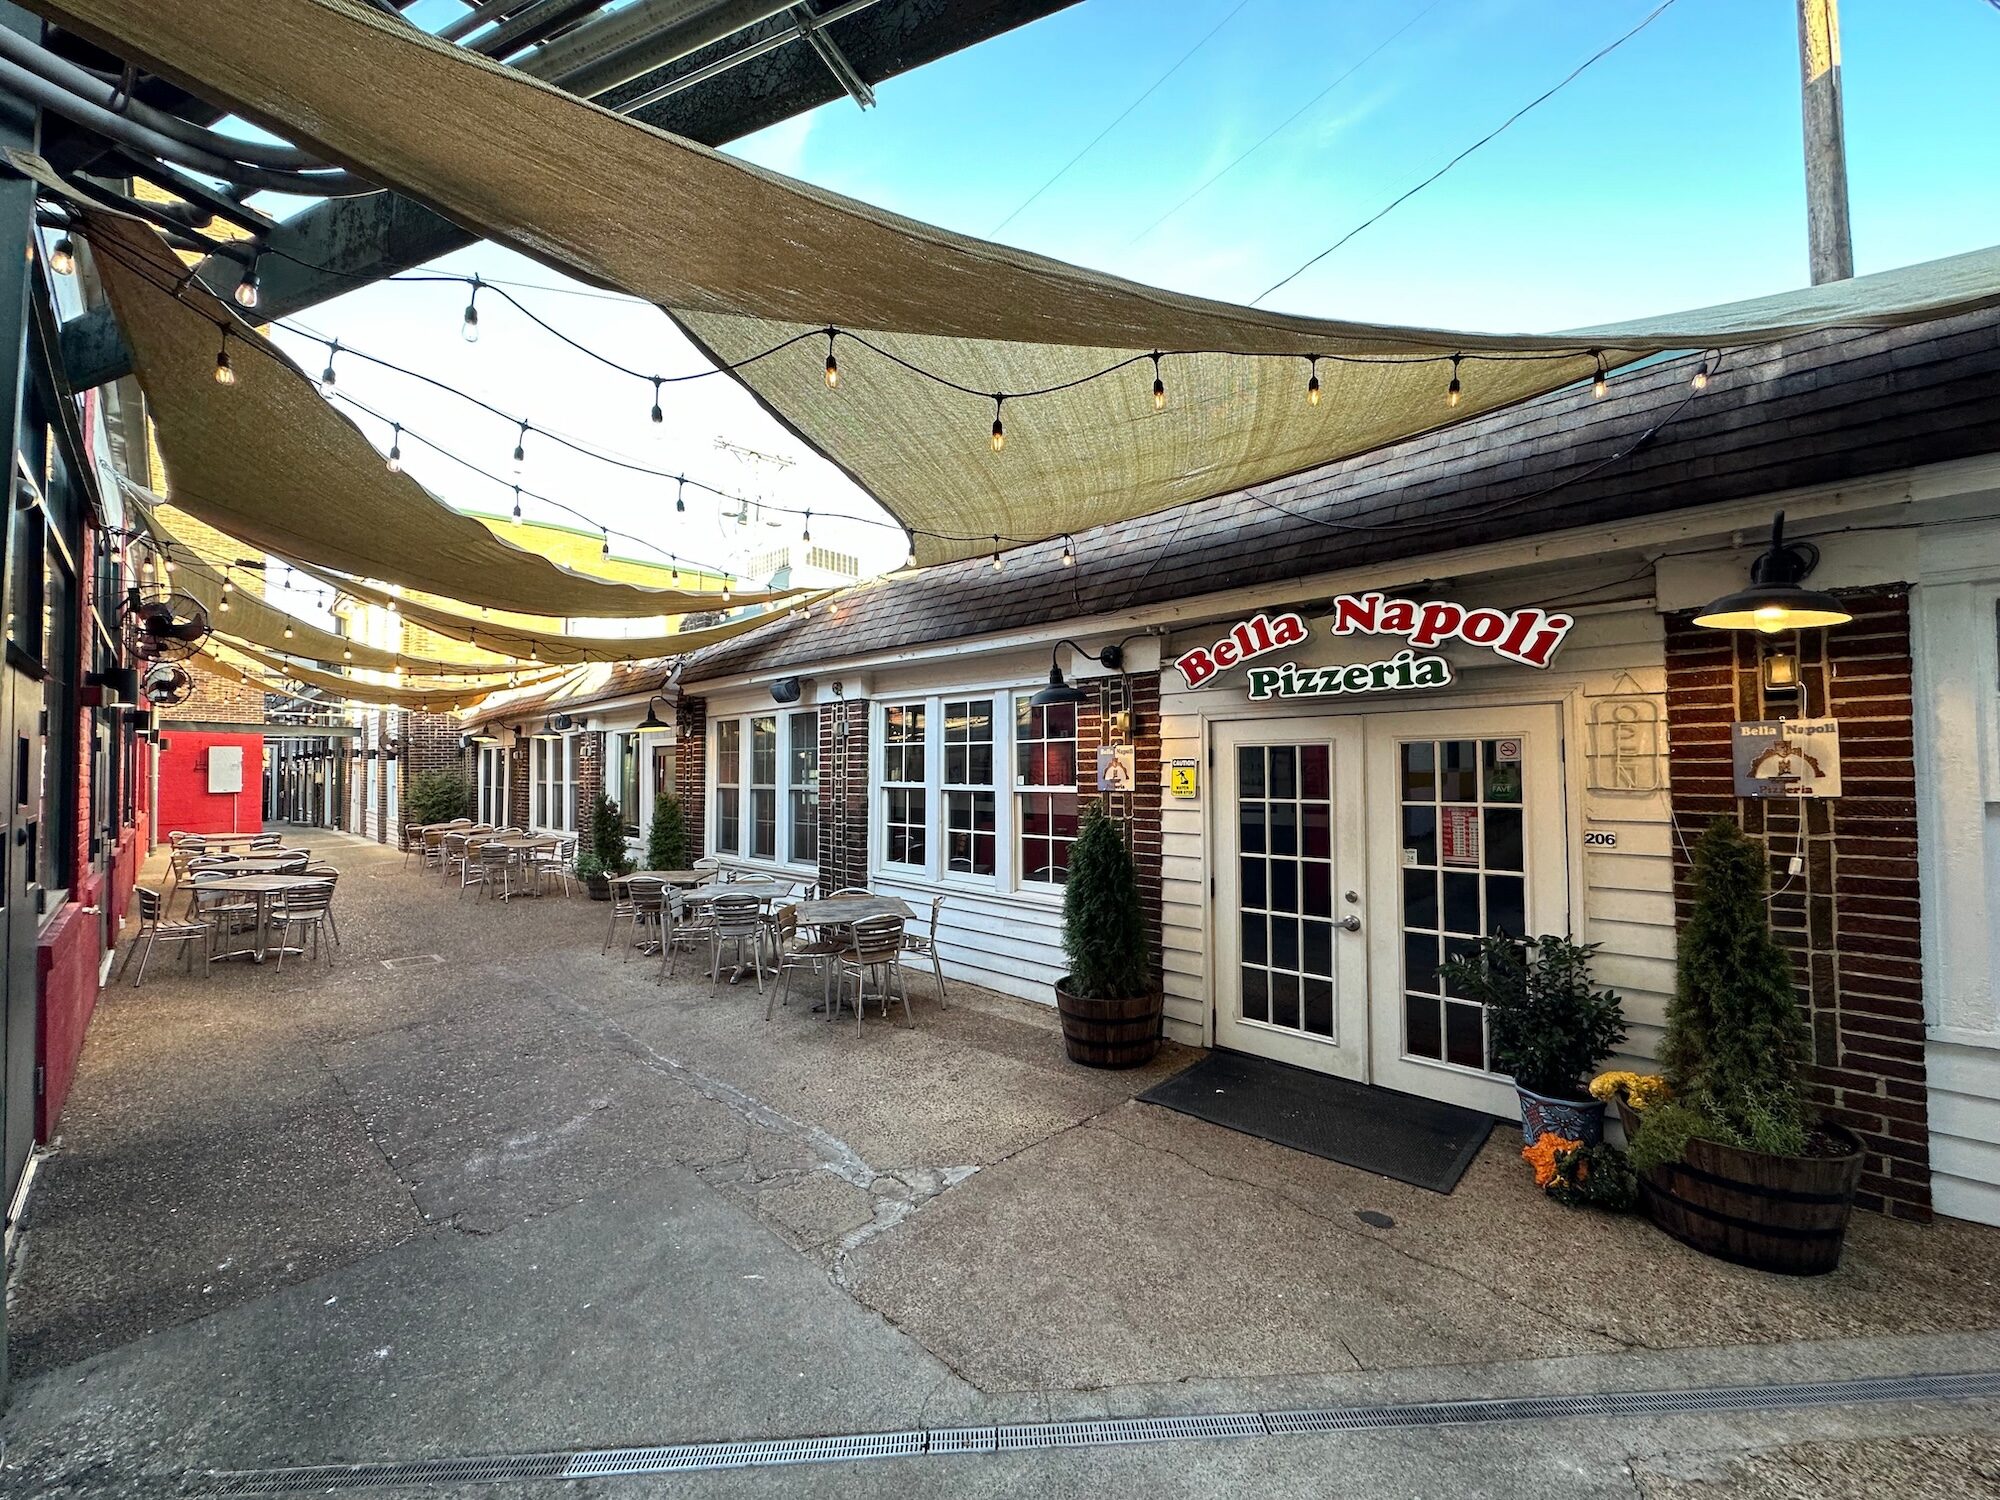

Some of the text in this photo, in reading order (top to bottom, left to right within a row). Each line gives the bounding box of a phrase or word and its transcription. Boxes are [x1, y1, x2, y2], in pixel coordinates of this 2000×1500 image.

[1177, 596, 1568, 686] Bella Napoli
[1249, 653, 1449, 697] Pizzeria
[1741, 726, 1777, 736] Bella
[1613, 704, 1639, 789] OPEN
[1492, 785, 1513, 793] FAVE
[1584, 833, 1616, 845] 206
